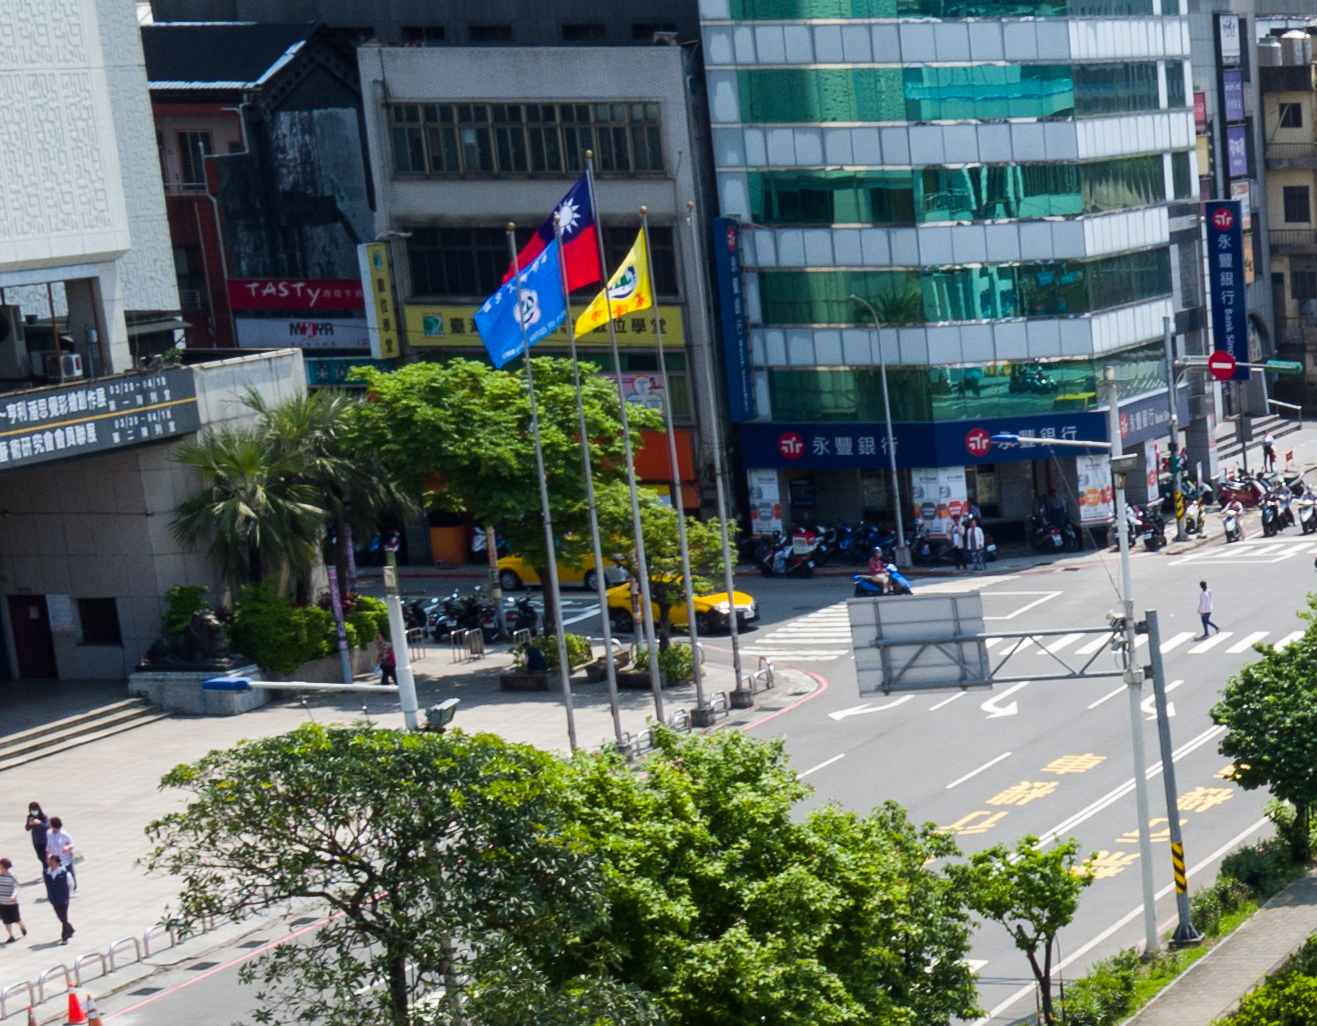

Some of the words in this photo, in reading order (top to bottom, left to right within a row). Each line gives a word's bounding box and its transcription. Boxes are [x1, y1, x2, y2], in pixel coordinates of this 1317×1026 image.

[1217, 233, 1235, 306] 永豐銀行
[812, 436, 899, 456] 永豐銀行
